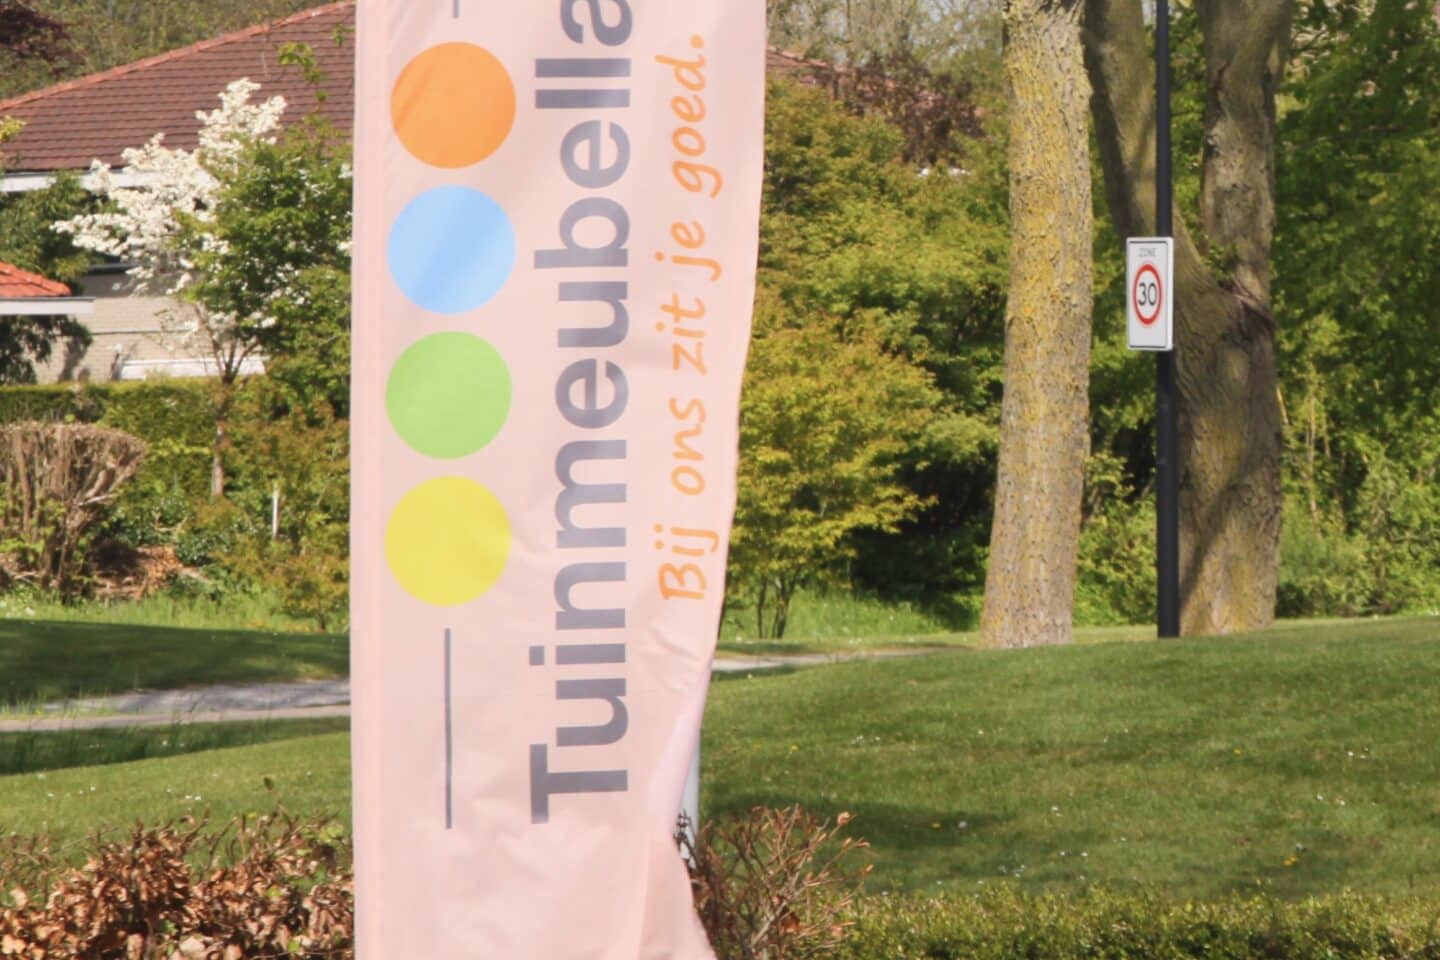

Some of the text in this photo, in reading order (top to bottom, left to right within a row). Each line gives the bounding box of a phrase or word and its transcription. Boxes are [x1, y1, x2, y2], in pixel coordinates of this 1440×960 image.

[653, 33, 724, 601] Bij ons zit je goed.
[1137, 282, 1158, 307] 30
